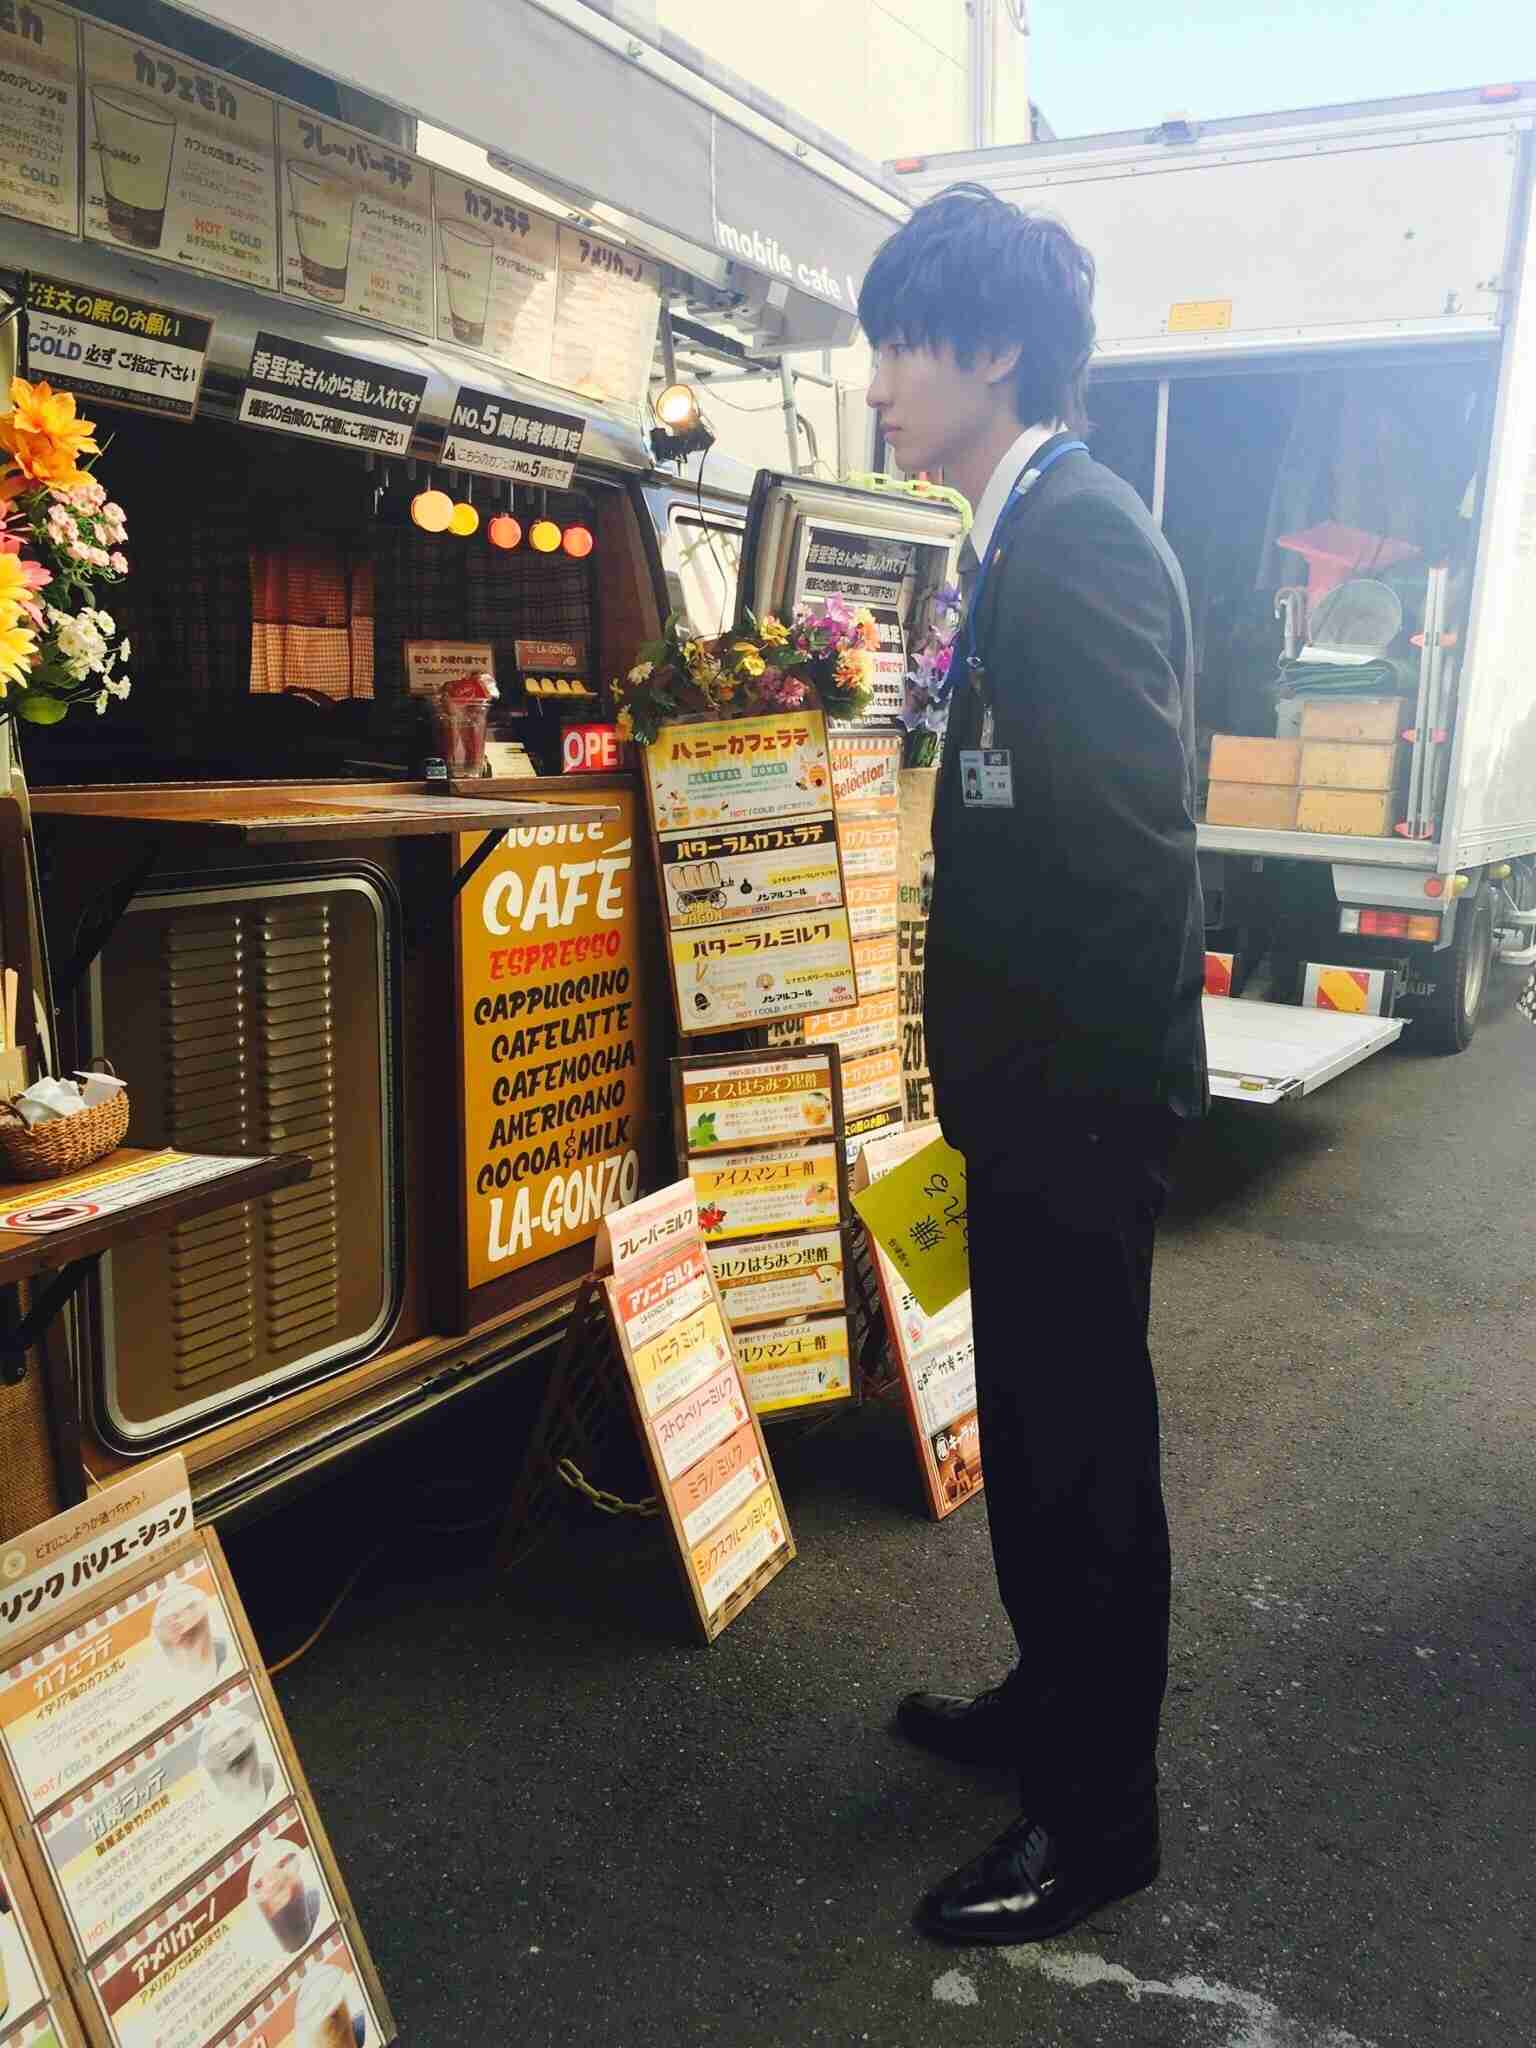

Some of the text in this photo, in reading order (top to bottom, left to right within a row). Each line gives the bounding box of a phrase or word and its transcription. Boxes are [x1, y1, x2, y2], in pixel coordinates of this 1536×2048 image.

[133, 50, 237, 120] カフェモカ
[297, 120, 414, 189] フレーバーラテ
[463, 188, 531, 238] カフェラテ
[578, 238, 644, 282] アメリカーノ
[717, 219, 794, 279] mobile
[797, 261, 842, 301] cafe
[39, 320, 78, 337] コールド
[28, 333, 197, 384] COLD 必ず ご指定下さい
[251, 350, 421, 415] 香里奈さんから差し入れです
[562, 730, 618, 768] OPE
[671, 727, 810, 761] ハニーカフェラテ
[676, 824, 825, 860] バターラムカフェラテ
[482, 836, 633, 937] CAFÉ
[488, 928, 621, 981] ESPRESSO
[692, 923, 832, 959] バターラムミルク
[473, 967, 630, 1026] CAPPUCCINO
[491, 1000, 633, 1064] CAFELATTE
[492, 1039, 636, 1107] CAFEMOCHA
[696, 1072, 817, 1100] アイスはちみつ黒酢
[488, 1079, 626, 1151] AMERICANO
[713, 1160, 816, 1188] アイスマンゴー酢
[487, 1149, 640, 1264] LA-GONZO
[618, 1207, 694, 1261] フレーバーミルク
[711, 1247, 829, 1280] ミルクはちみつ黒酢
[648, 1320, 706, 1372] バニラミルク
[738, 1335, 828, 1364] ルクマンゴー酢
[658, 1377, 734, 1443] ストロベリーミルク
[71, 1504, 188, 1588] バリエーション
[696, 1496, 775, 1582] ミックスフルーツミルク
[32, 1631, 114, 1699] カフェラテ
[131, 1896, 217, 1985] アメリカーノ
